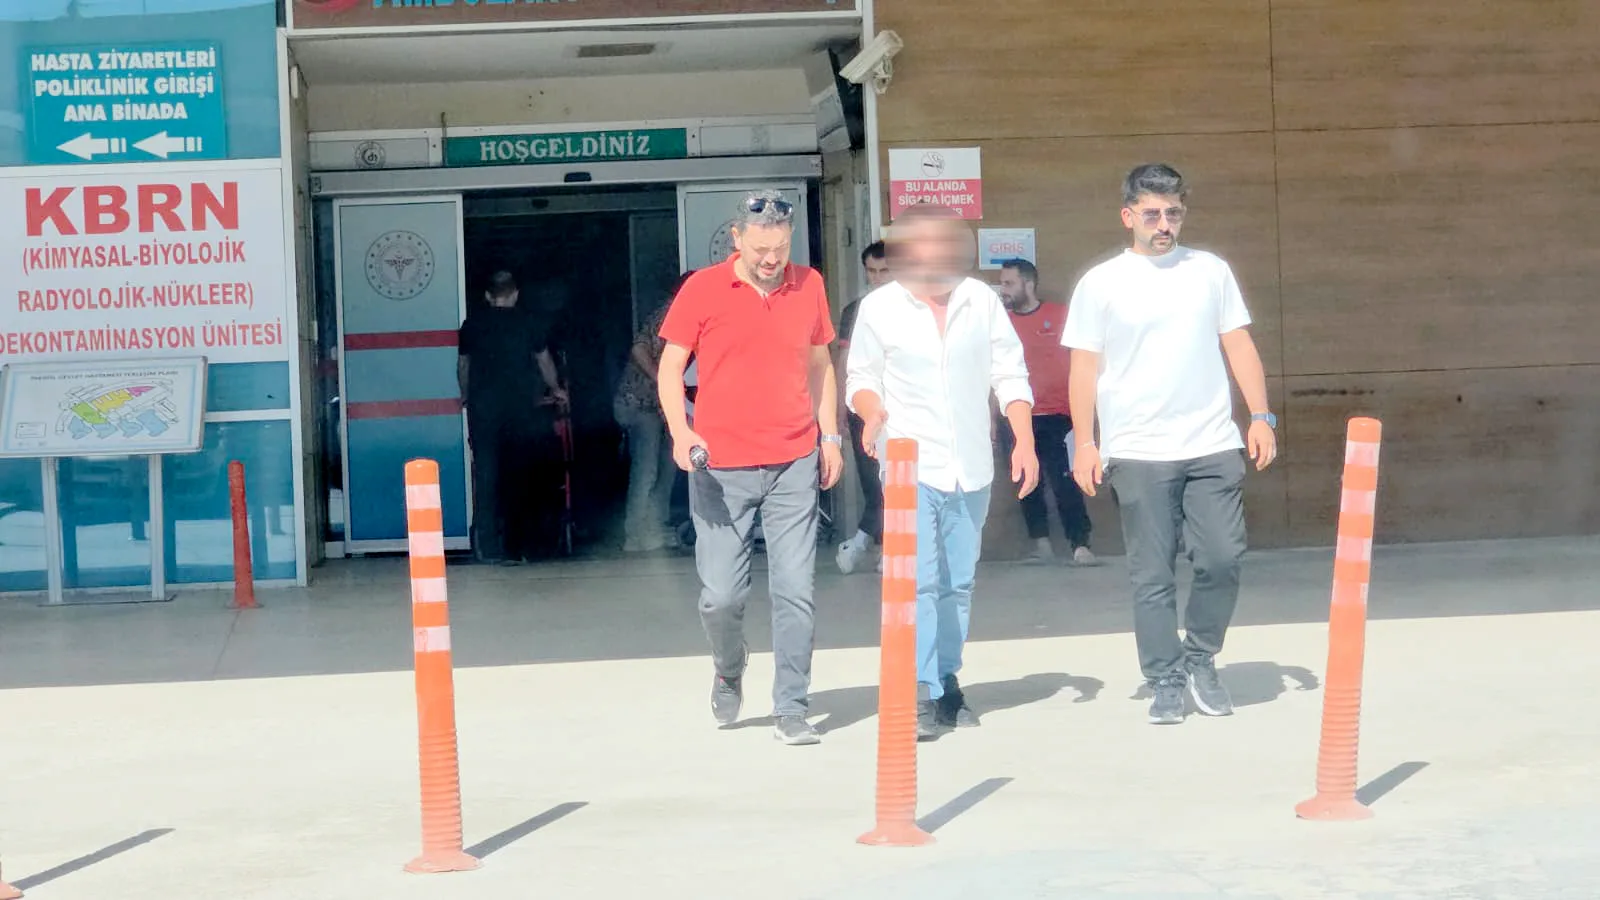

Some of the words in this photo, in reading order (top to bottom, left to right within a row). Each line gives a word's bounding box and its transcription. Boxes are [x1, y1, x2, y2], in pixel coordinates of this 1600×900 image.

[31, 53, 95, 72] HASTA
[98, 47, 216, 71] ZİYARETLERİ
[35, 73, 149, 97] POLİKLİNİK
[154, 71, 215, 99] GİRİŞİ
[63, 104, 107, 122] ANA
[112, 98, 188, 121] BİNADA
[479, 131, 651, 162] HOŞGELDİNİZ
[906, 181, 920, 192] BU
[923, 180, 967, 192] ALANDA
[941, 192, 975, 207] İÇMEK
[24, 181, 239, 237] KBRN
[22, 235, 246, 275] (KİMYASAL-BİYOLOJİK
[17, 280, 255, 312] RADYOLOJİK-NÜKLEER)
[202, 317, 283, 347] ÜNİTESİ
